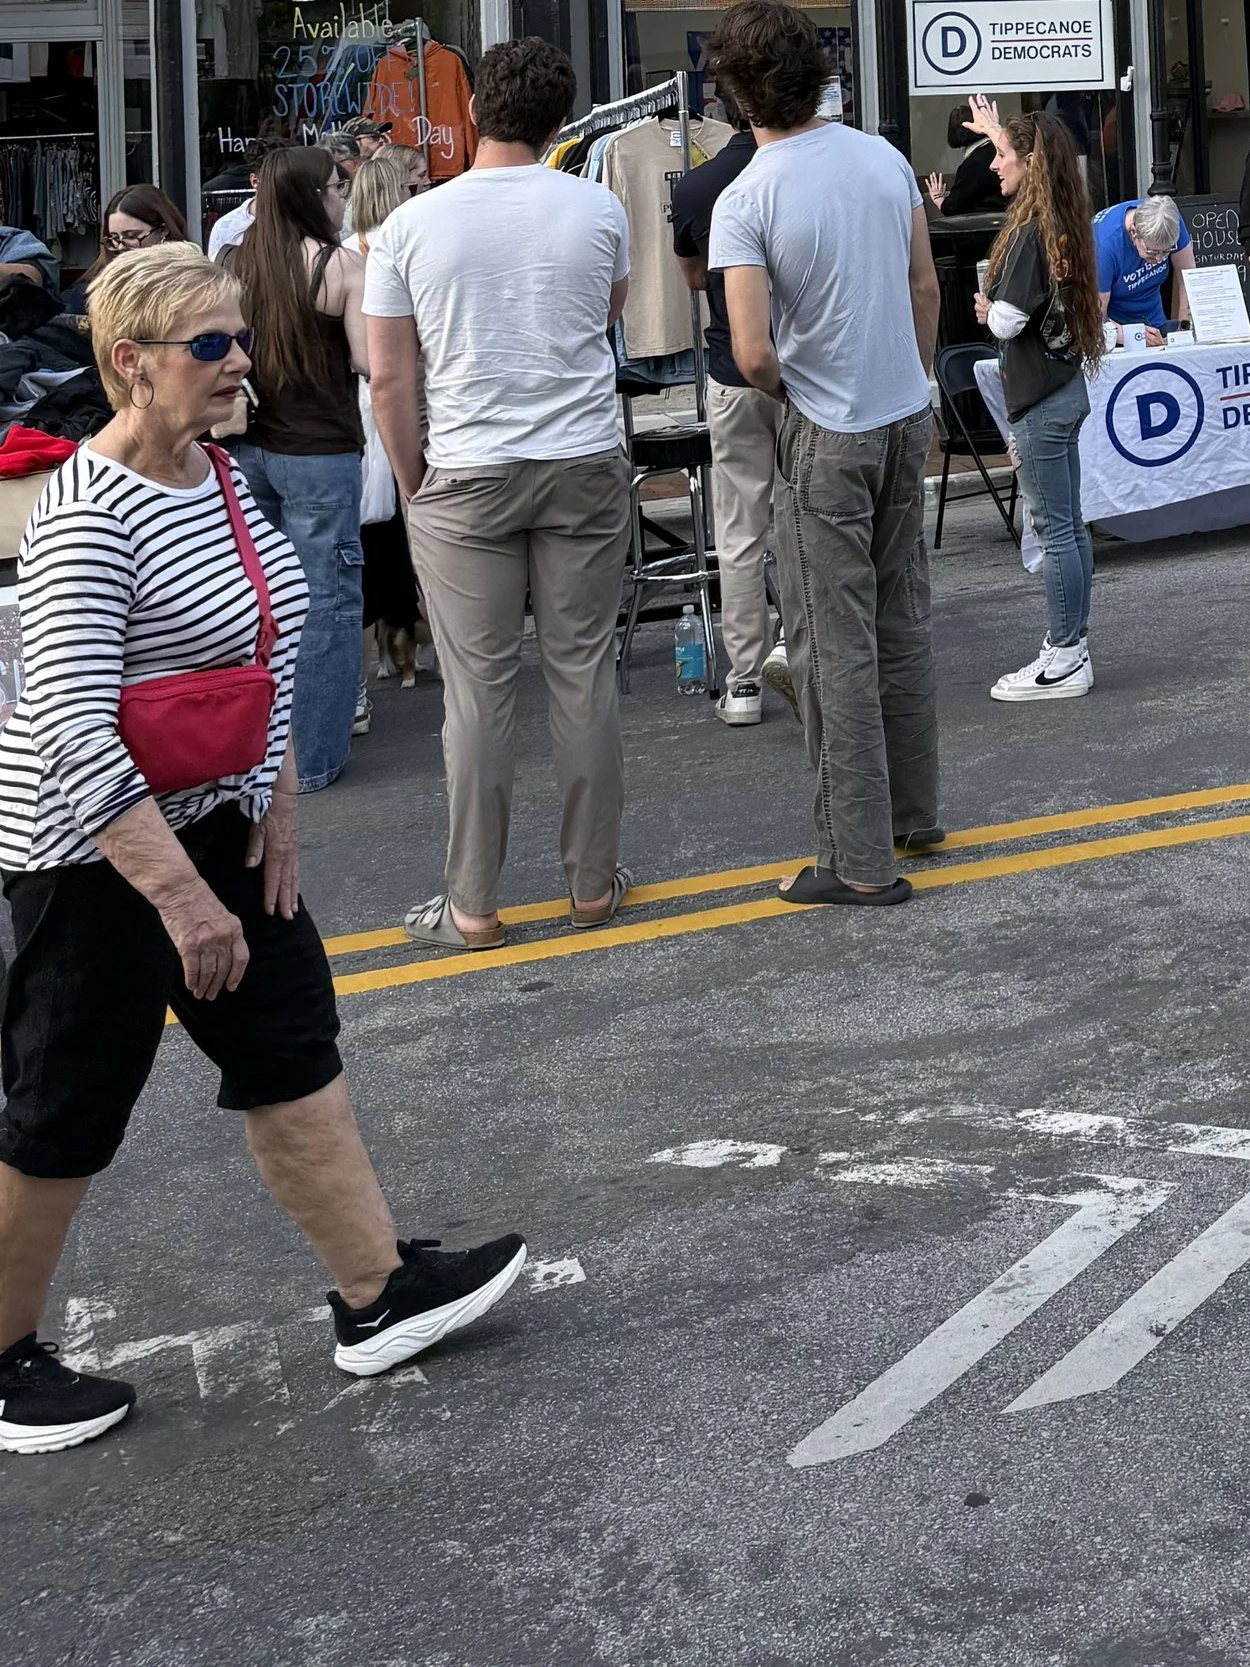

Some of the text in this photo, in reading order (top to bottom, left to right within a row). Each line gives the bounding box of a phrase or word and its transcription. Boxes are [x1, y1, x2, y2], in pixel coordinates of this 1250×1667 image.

[293, 2, 393, 40] Available
[989, 20, 1092, 36] TIPPECANOE
[991, 44, 1092, 60] DEMOCRATS
[273, 45, 345, 81] 25%
[412, 116, 453, 159] Day
[1192, 209, 1240, 229] OPEN
[1194, 252, 1246, 264] SATURDAY
